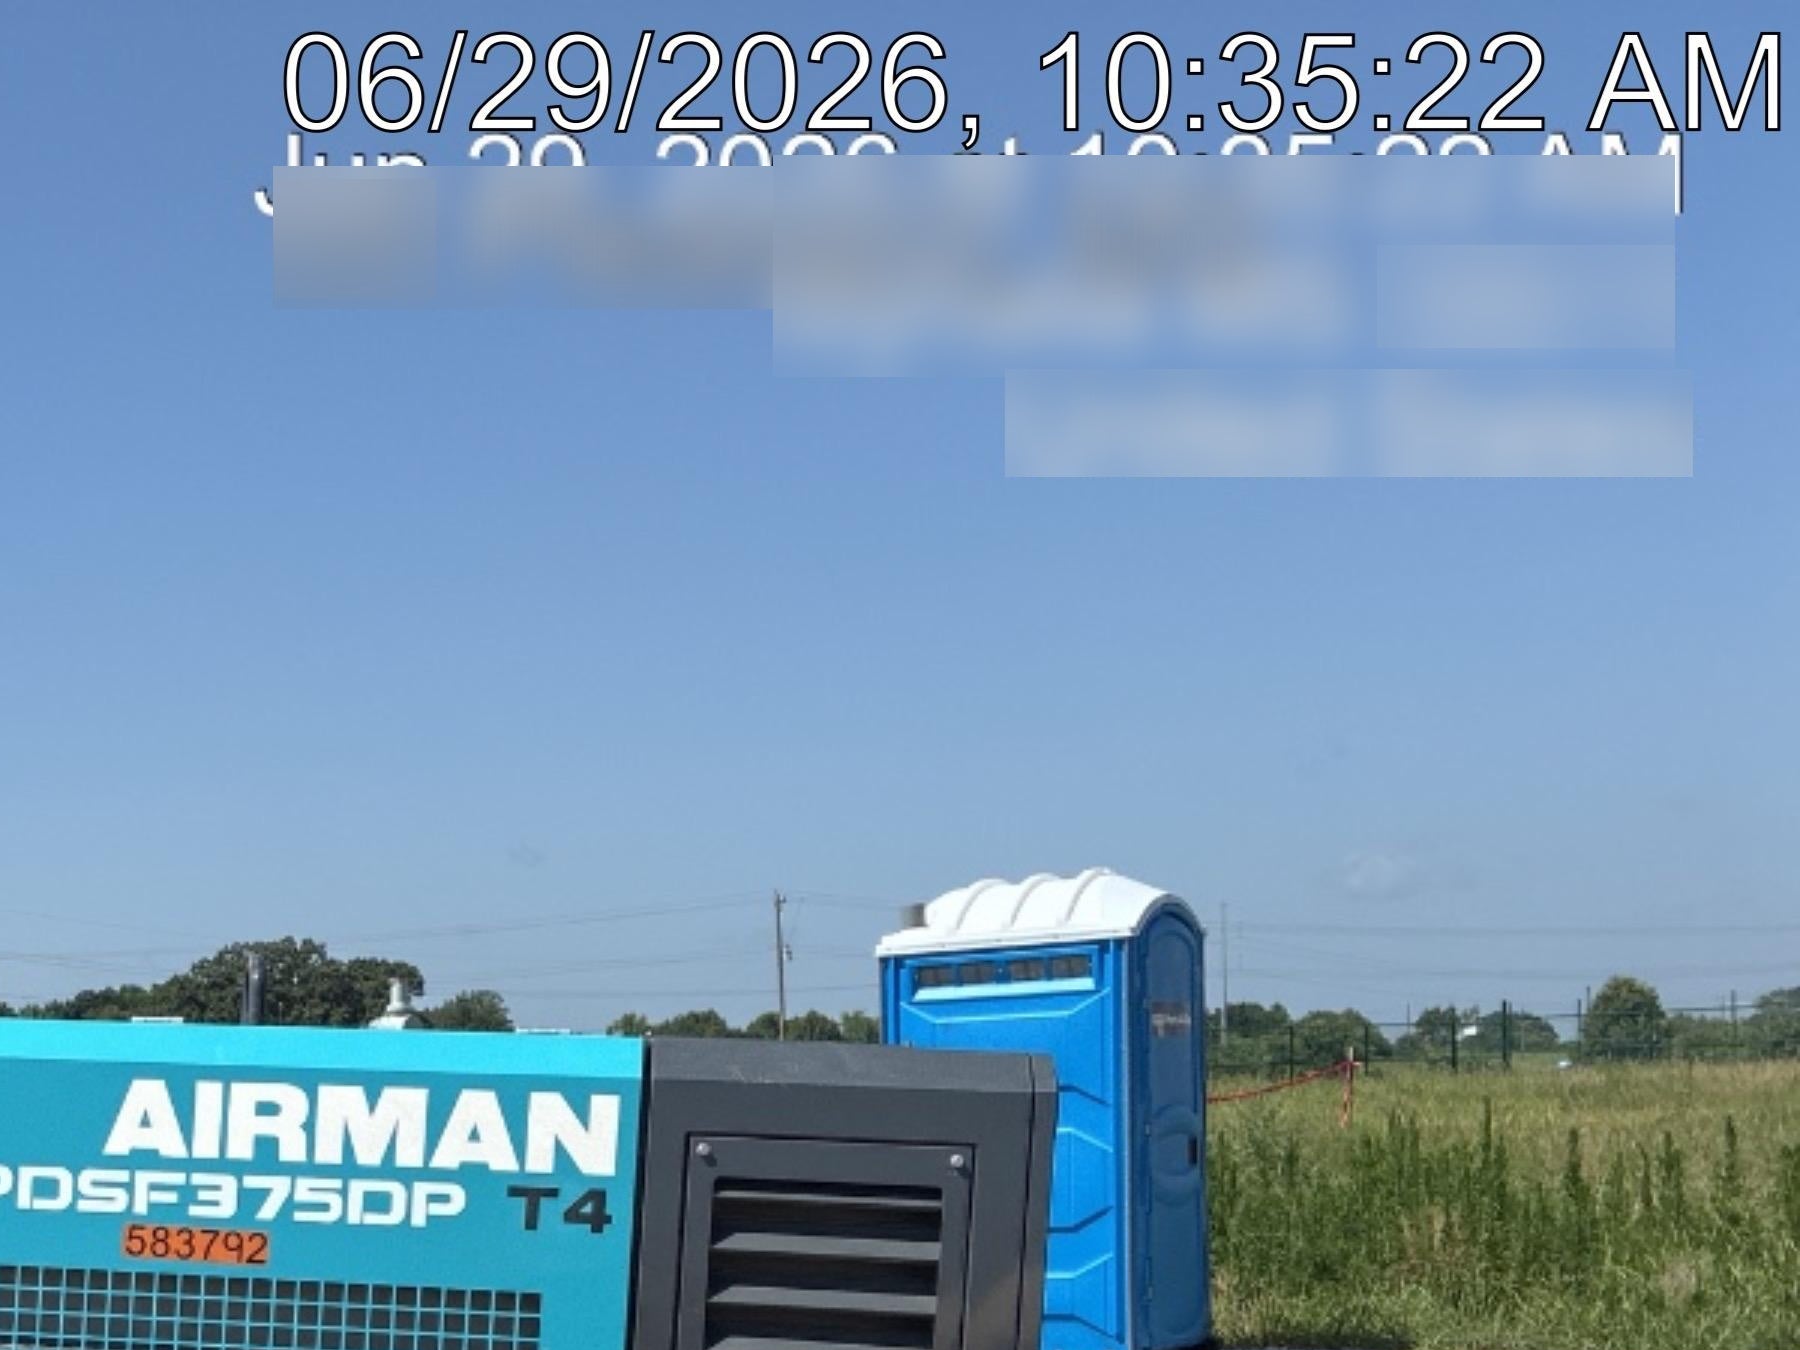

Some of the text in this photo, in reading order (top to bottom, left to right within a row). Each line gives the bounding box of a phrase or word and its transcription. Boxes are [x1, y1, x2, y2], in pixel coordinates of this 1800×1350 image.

[104, 1079, 620, 1177] AIRMAN
[507, 1186, 613, 1234] T4
[124, 1224, 269, 1265] 583792
